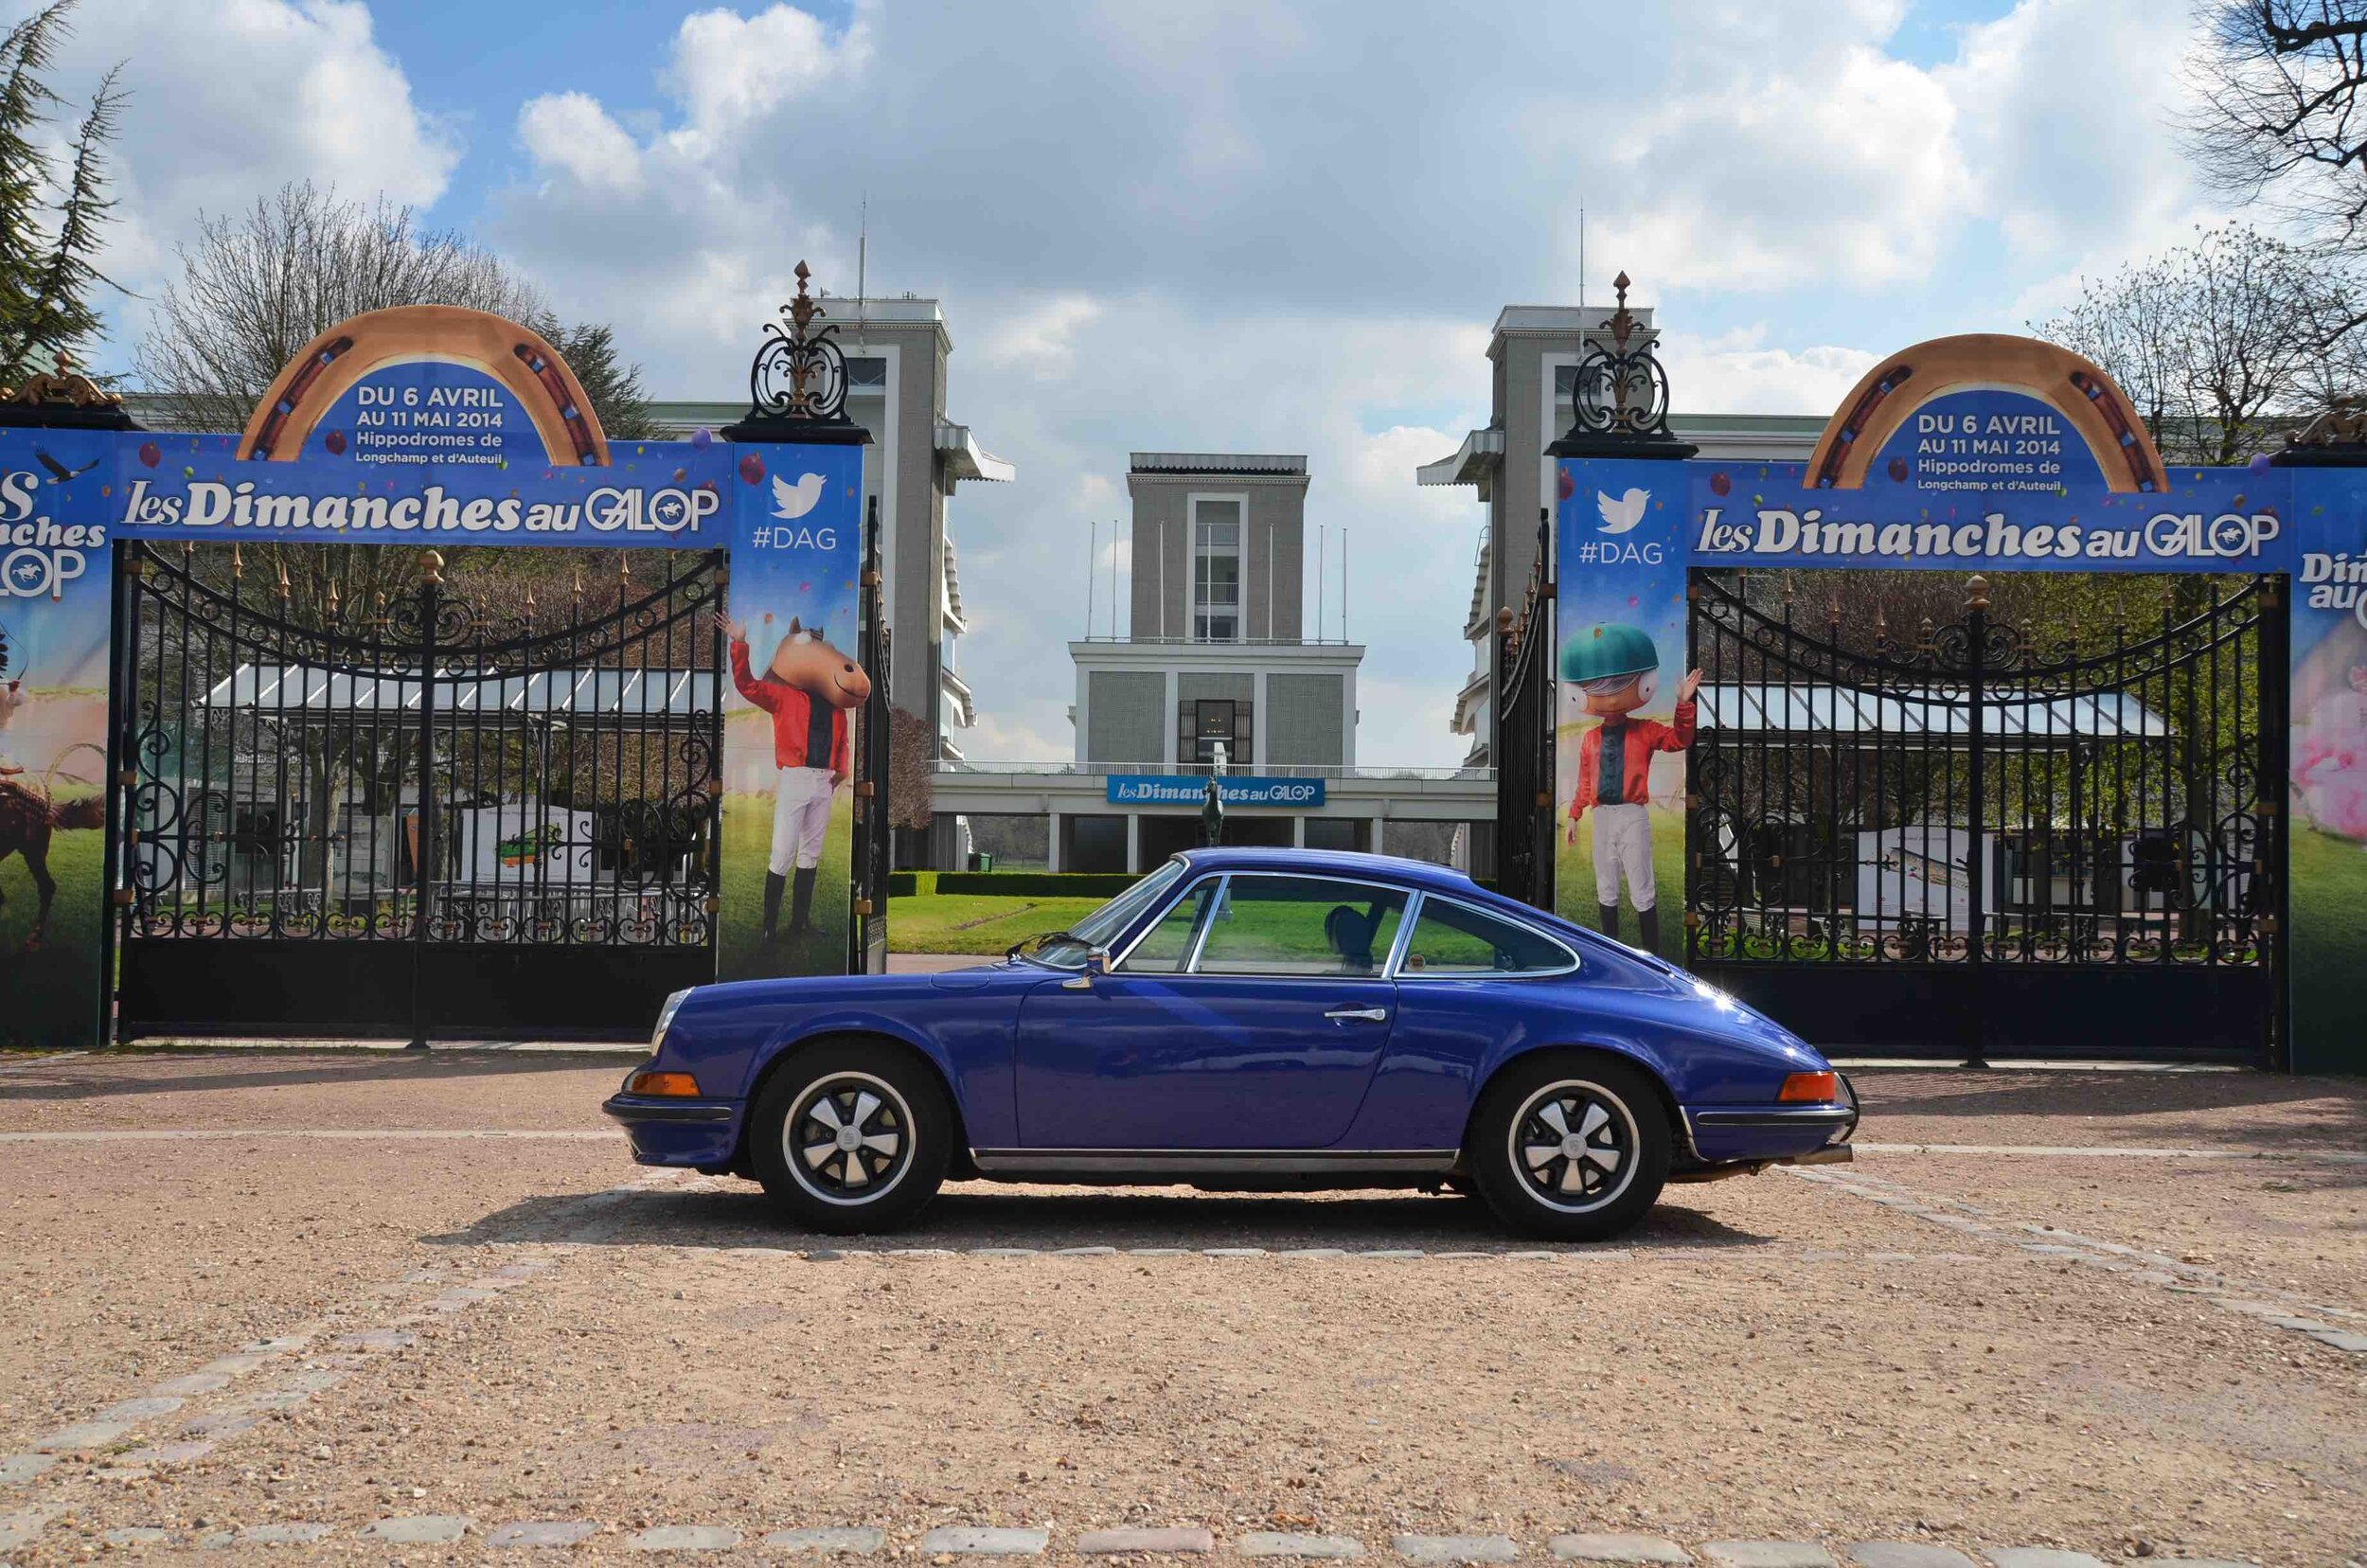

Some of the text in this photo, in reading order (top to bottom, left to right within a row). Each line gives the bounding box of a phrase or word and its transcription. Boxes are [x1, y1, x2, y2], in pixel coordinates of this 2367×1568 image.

[358, 386, 504, 407] DU 6 AVRIL
[357, 410, 503, 428] AU 11 MAI 2014
[1918, 415, 2060, 435] DU 6 AVRIL
[357, 431, 503, 448] Hippodromes de
[1918, 438, 2060, 455] AU 11 MAI 2014
[355, 452, 502, 465] Longchamp et d'Auteuil
[1918, 458, 2060, 475] Hippodromes de
[1917, 479, 2061, 491] Longchamp et d'Auteuil
[183, 482, 522, 532] Dimanches
[525, 503, 580, 532] au
[584, 487, 720, 532] GALOP
[752, 526, 837, 550] #DAG
[1753, 509, 2082, 558] Dimanches
[2085, 529, 2140, 558] au
[2144, 513, 2280, 558] GALOP
[1578, 541, 1664, 565] #DAG
[2308, 584, 2359, 609] au
[1136, 783, 1249, 801] Dimanhes
[1251, 790, 1269, 801] au
[1269, 785, 1316, 801] GALOP
